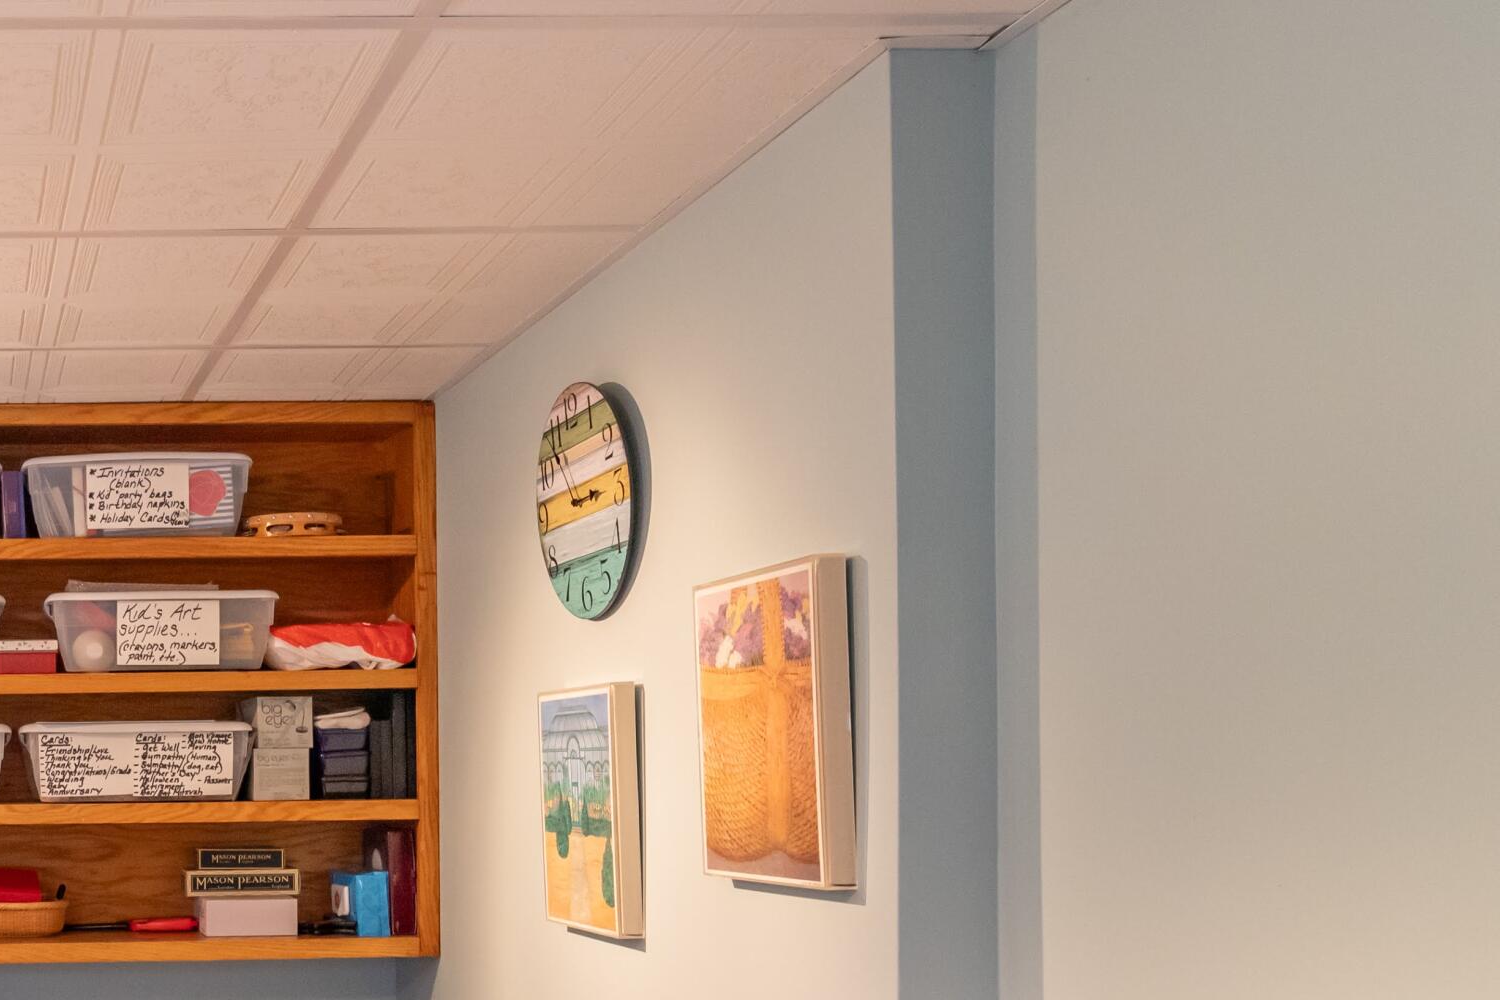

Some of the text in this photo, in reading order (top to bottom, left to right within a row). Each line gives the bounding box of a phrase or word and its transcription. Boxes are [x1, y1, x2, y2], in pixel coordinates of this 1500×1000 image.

[563, 392, 578, 431] 12
[602, 423, 614, 461] 2
[97, 465, 165, 478] Invitations
[110, 477, 151, 492] (blank)
[613, 468, 625, 506] 3
[98, 500, 185, 513] Birthday napkins
[100, 512, 135, 526] Holiday
[140, 511, 170, 524] Cards
[538, 502, 549, 536] 9
[563, 566, 572, 602] 7
[600, 558, 612, 595] 5
[581, 576, 593, 612] 6
[122, 603, 202, 622] Kid's Art
[170, 640, 218, 652] markers,
[261, 700, 283, 716] big
[162, 743, 180, 752] Well
[45, 761, 71, 769] Thank
[47, 776, 84, 788] Wedding
[196, 875, 289, 890] MASON PEARSON
